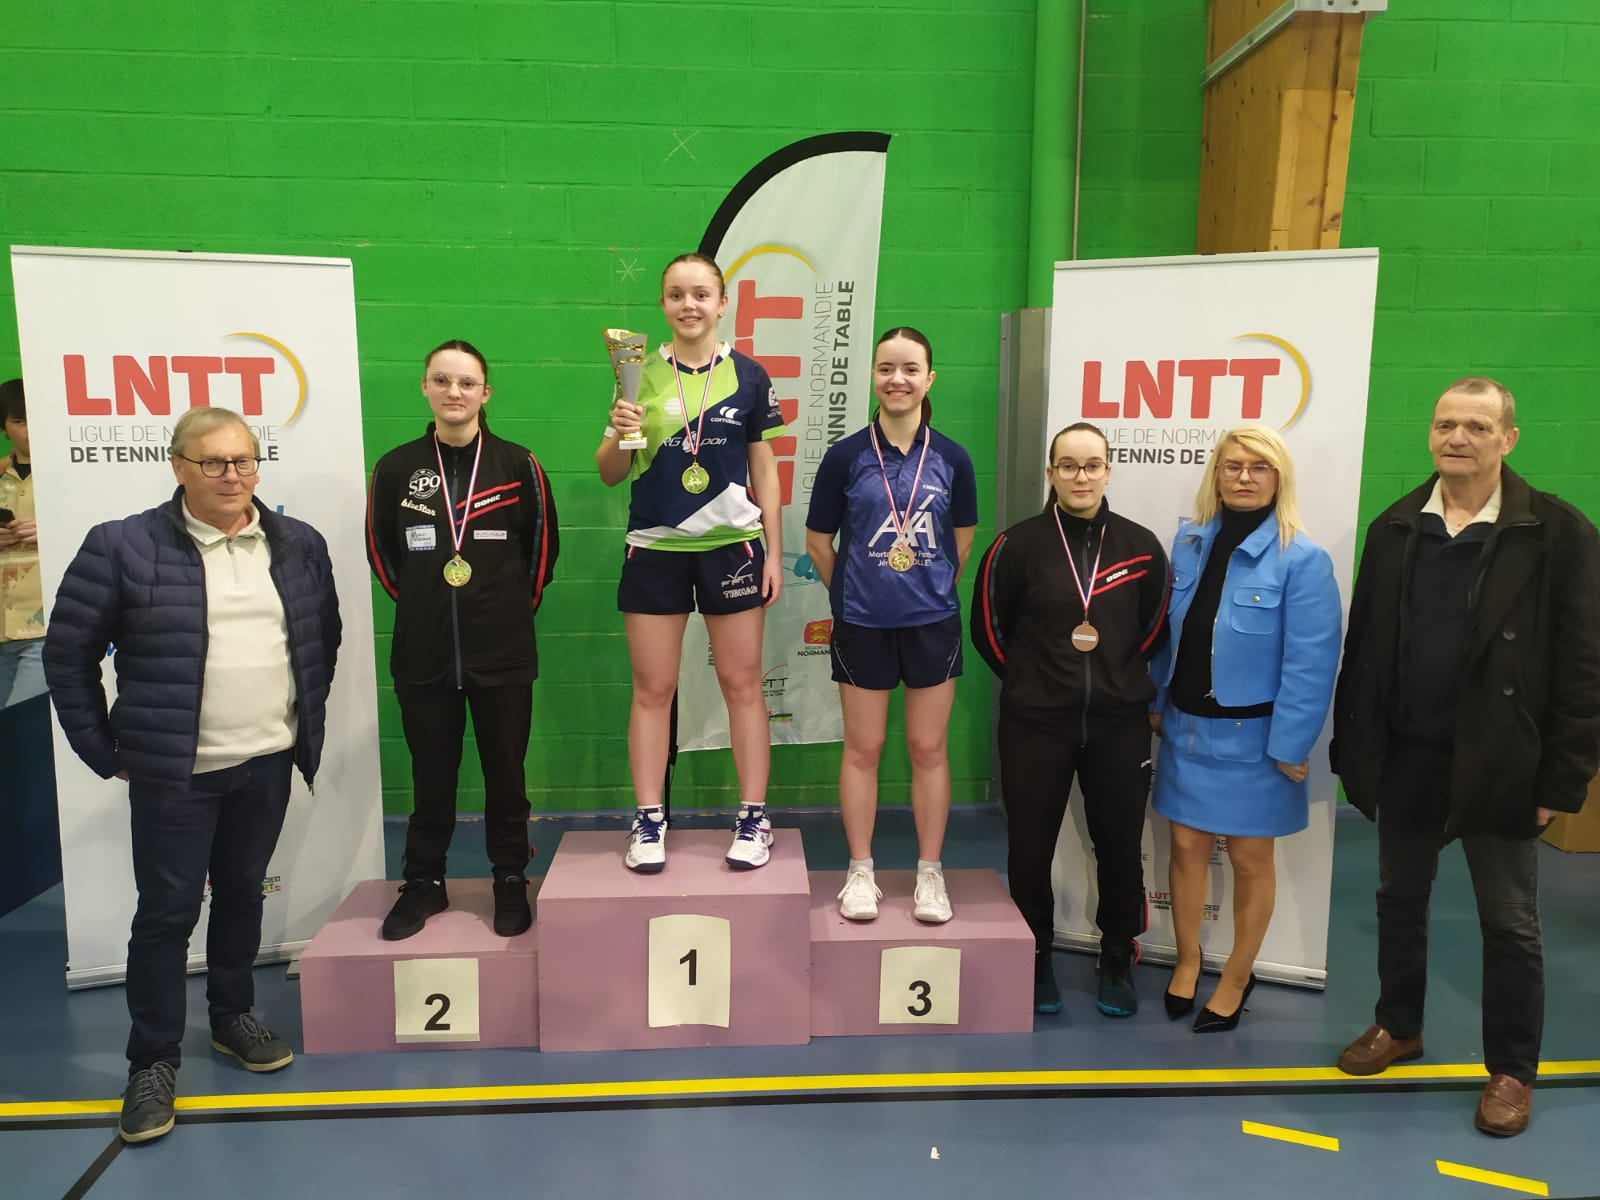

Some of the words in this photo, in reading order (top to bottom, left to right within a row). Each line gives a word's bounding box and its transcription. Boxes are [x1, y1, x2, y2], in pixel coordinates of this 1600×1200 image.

[833, 280, 855, 352] TABLE
[808, 281, 834, 408] NORMANDIE
[63, 354, 275, 416] LNTT
[830, 356, 849, 386] DE
[1081, 358, 1281, 419] LNTT
[69, 425, 125, 442] LIGUE
[131, 425, 157, 443] DE
[806, 415, 823, 441] DE
[827, 391, 847, 448] NNIS
[1133, 428, 1157, 444] DE
[70, 446, 98, 463] DE
[1109, 447, 1175, 464] TENNIS
[1180, 449, 1205, 464] DE
[409, 475, 441, 496] SPO
[868, 511, 937, 549] AXA
[680, 948, 698, 986] 1
[424, 993, 452, 1031] 2
[907, 980, 933, 1017] 3
